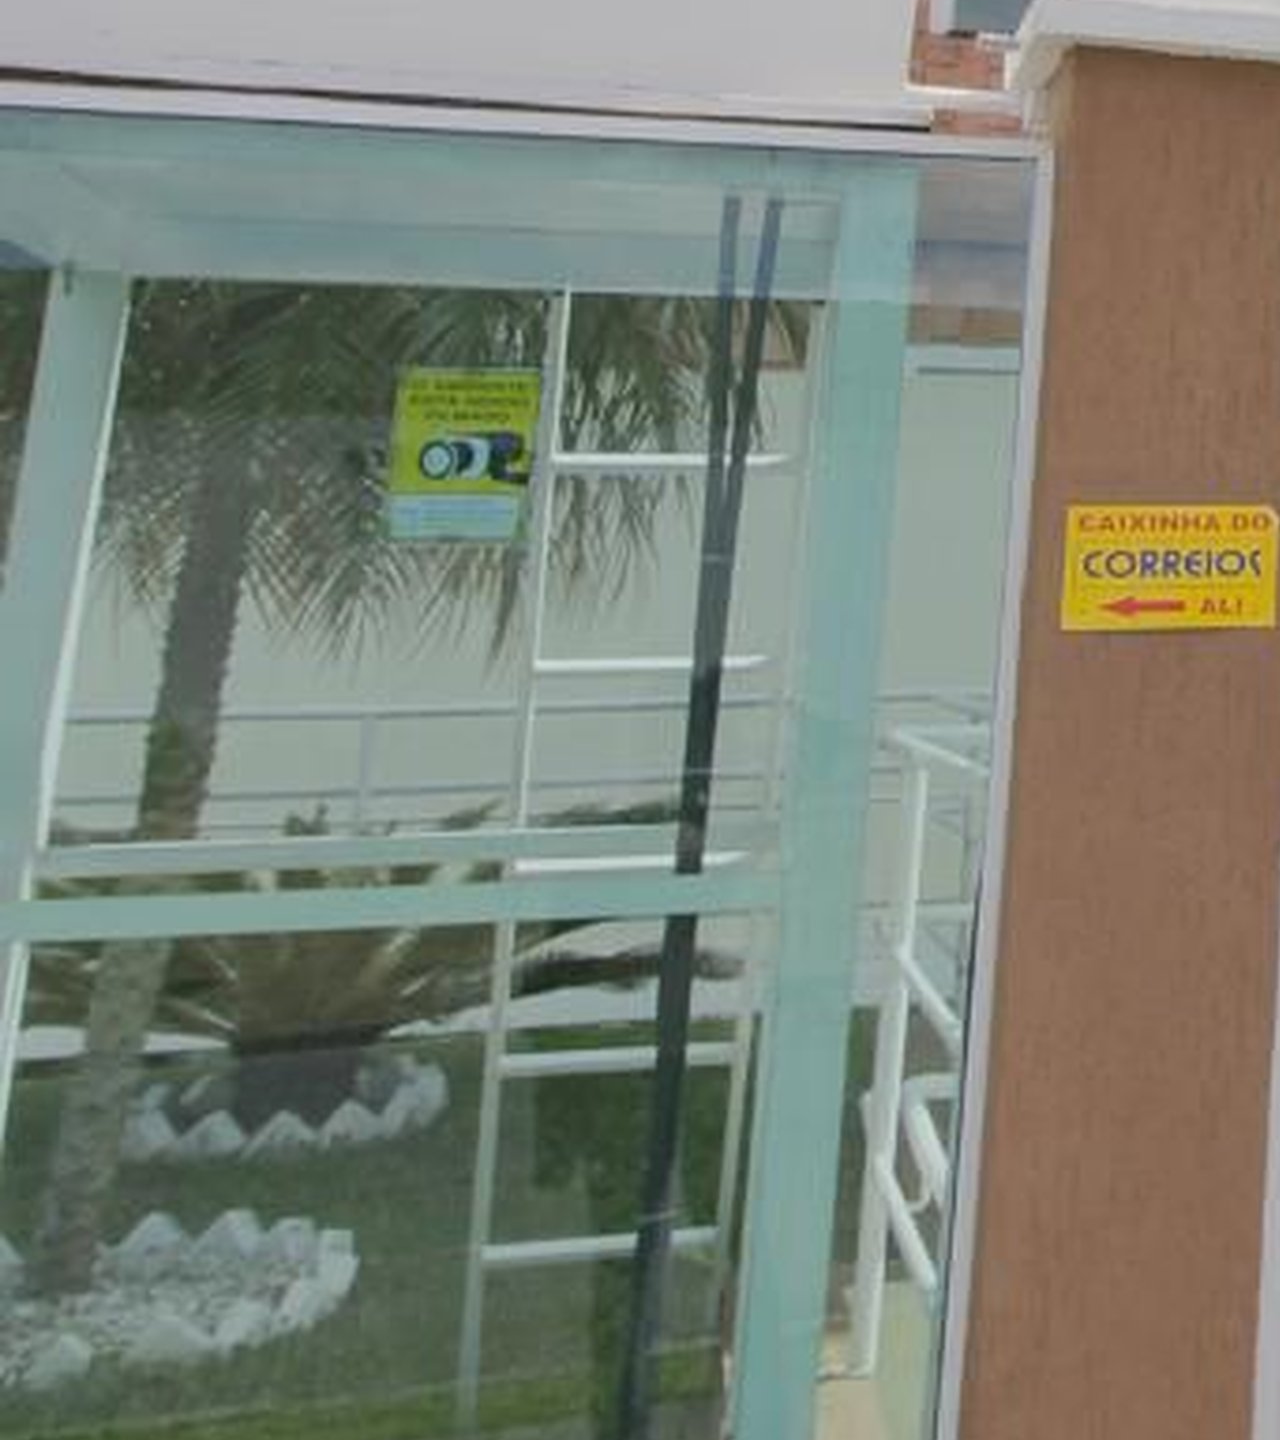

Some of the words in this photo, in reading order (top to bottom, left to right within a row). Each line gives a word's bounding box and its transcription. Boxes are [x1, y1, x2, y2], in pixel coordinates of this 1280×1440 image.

[1079, 511, 1221, 535] CAIXINHA
[1231, 511, 1272, 532] DO
[1082, 549, 1263, 579] CORREIOS
